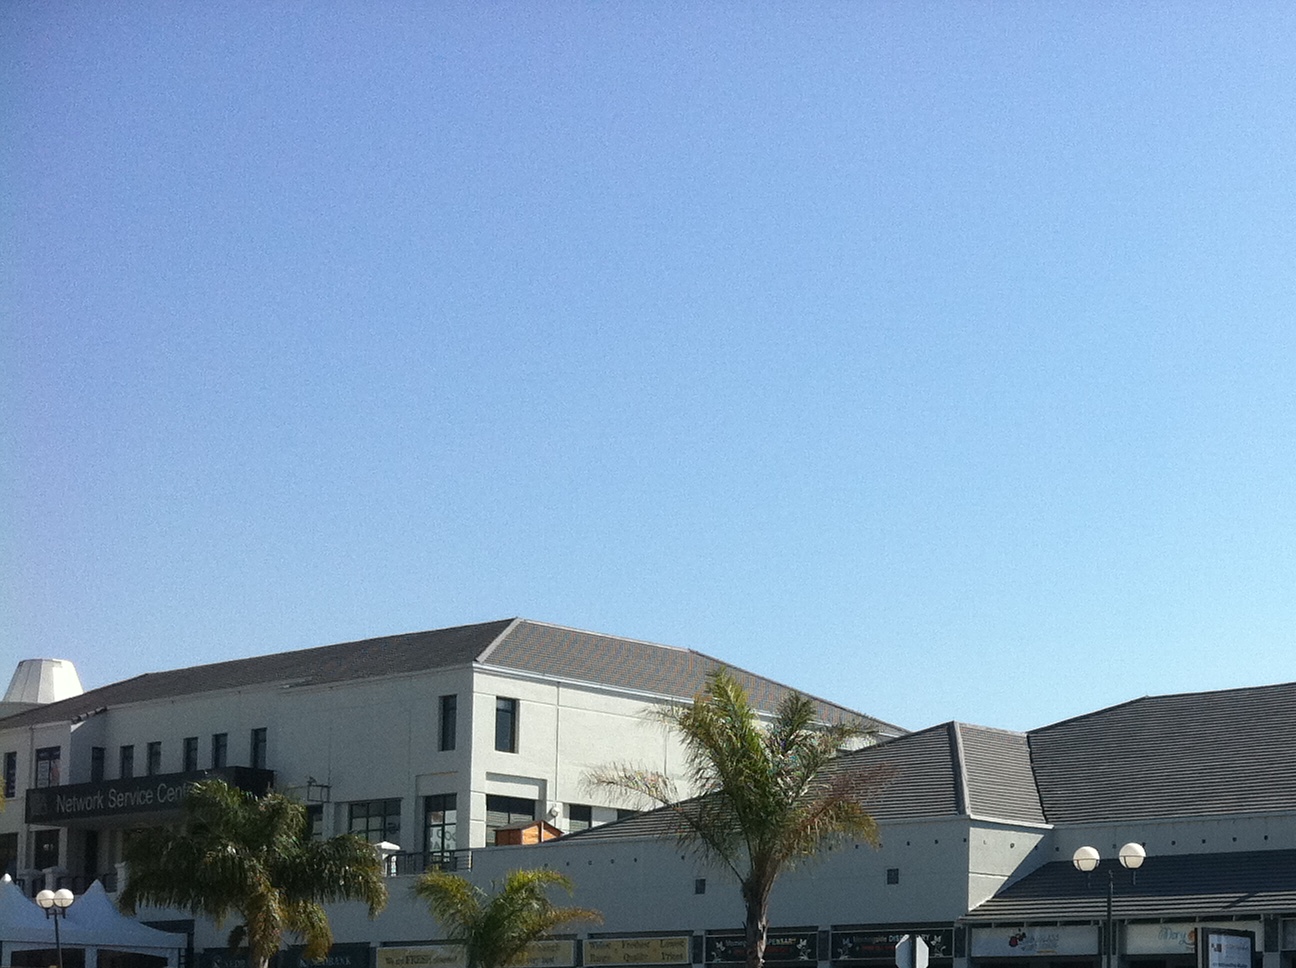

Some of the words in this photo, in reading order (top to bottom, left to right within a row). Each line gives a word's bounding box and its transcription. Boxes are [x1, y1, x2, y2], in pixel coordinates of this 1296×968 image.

[55, 790, 104, 813] Network
[108, 786, 153, 809] Service
[156, 782, 192, 803] Centr
